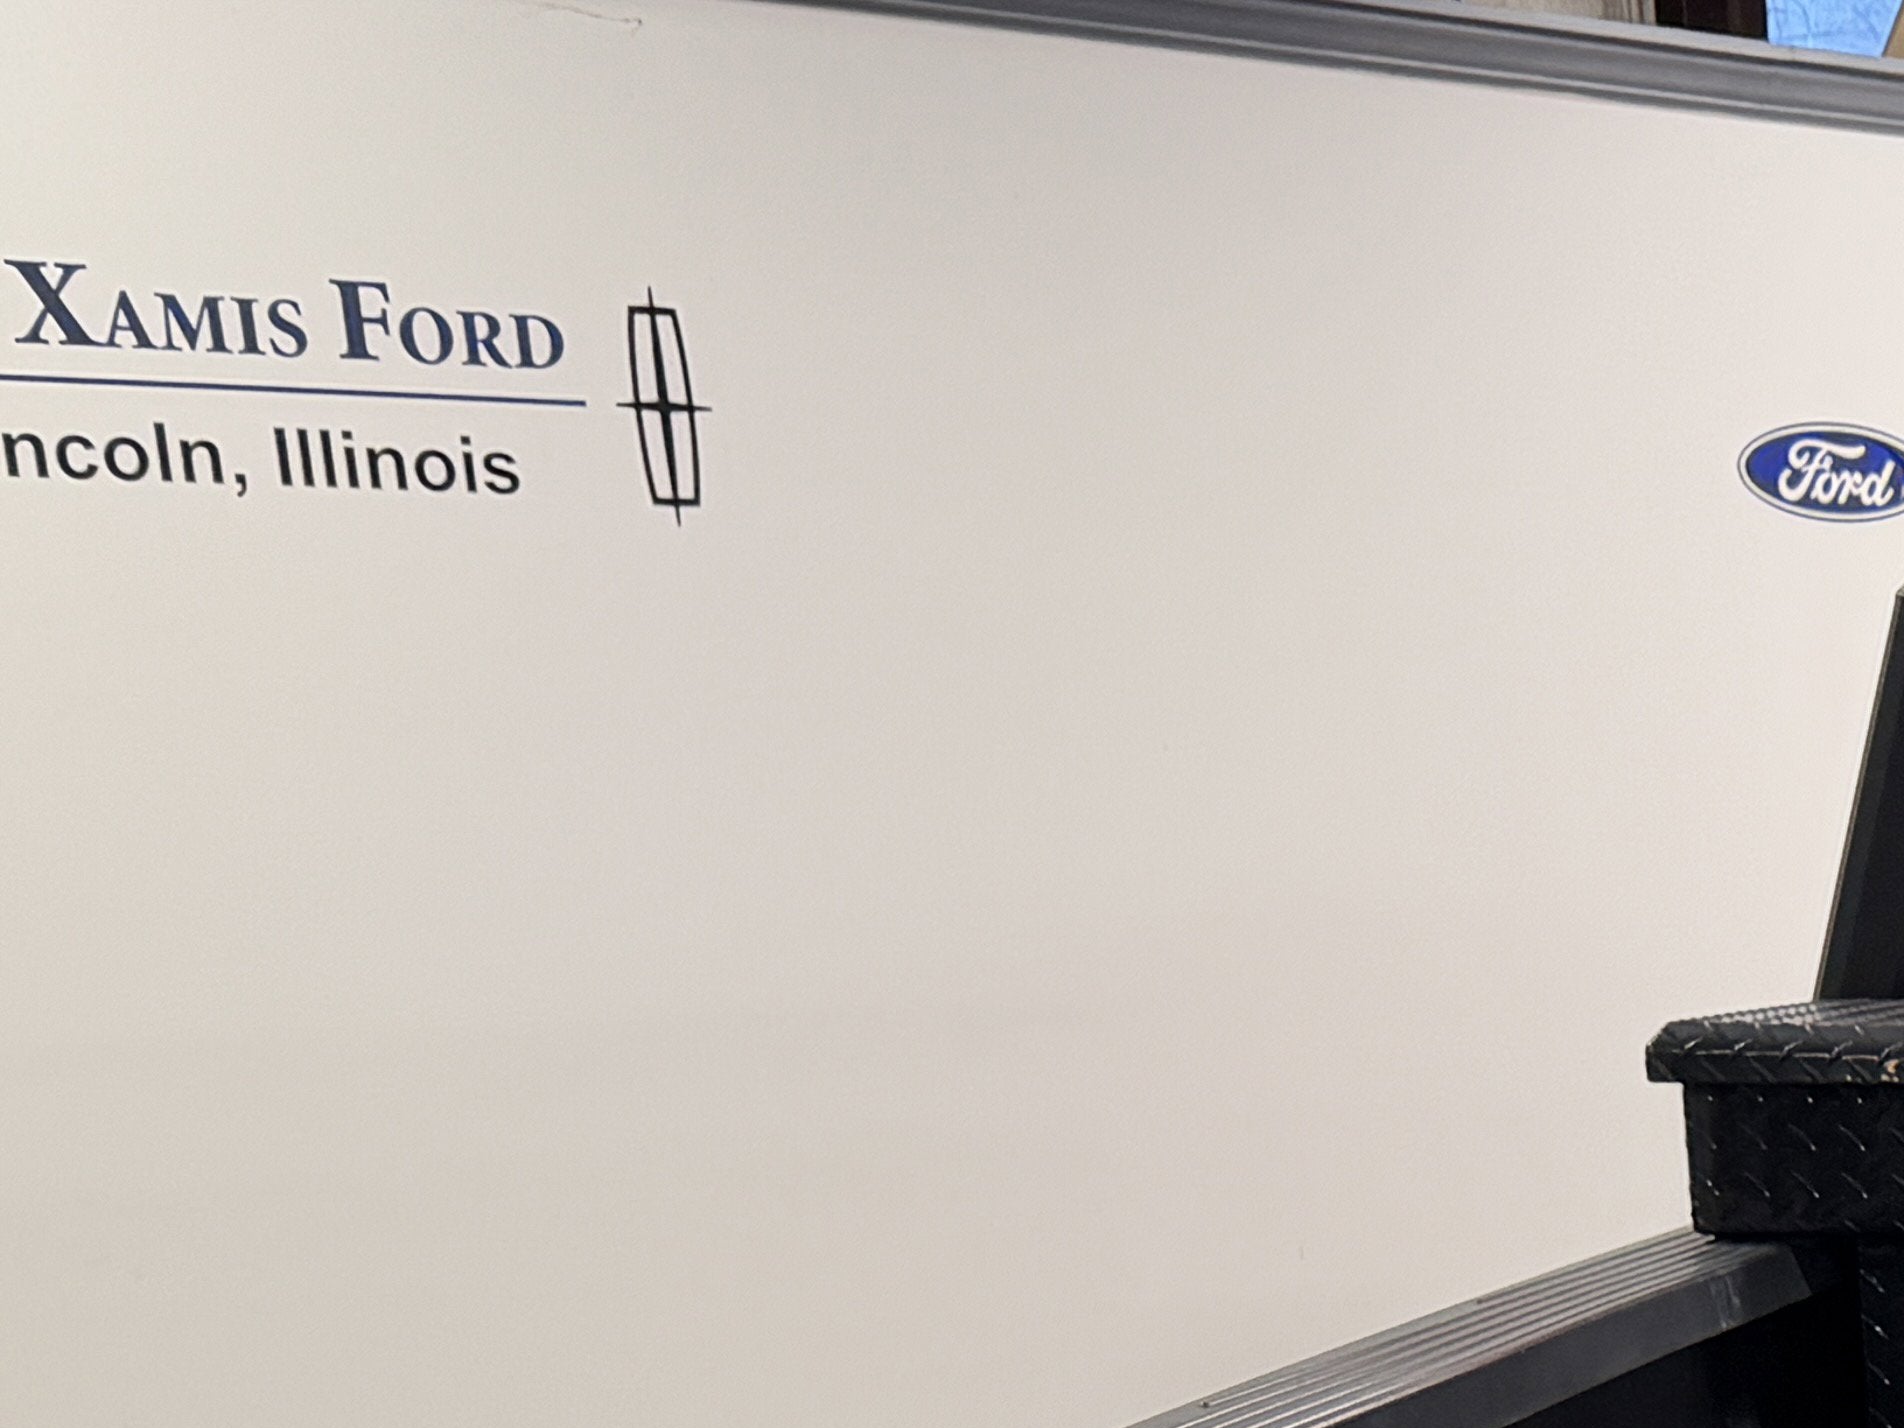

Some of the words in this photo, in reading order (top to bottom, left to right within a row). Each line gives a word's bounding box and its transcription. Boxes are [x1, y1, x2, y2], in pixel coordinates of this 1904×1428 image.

[4, 259, 307, 357] XAMIS
[329, 279, 564, 369] FORD
[1, 423, 247, 497] ncoln,
[274, 428, 520, 494] Illinois
[1778, 438, 1894, 506] Ford
